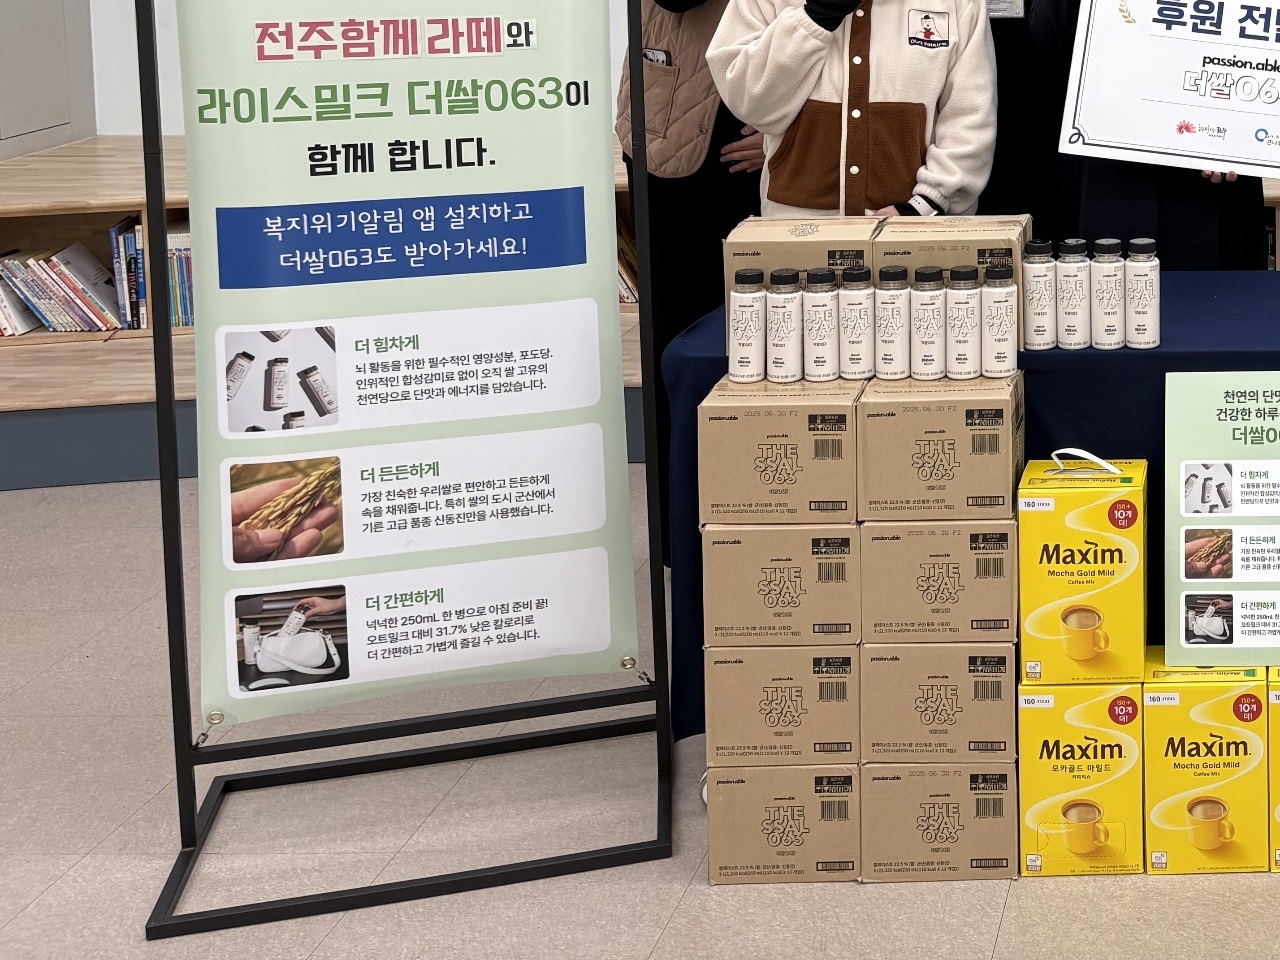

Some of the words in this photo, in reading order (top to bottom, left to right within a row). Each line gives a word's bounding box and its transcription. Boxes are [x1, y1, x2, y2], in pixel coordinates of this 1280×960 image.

[255, 17, 420, 61] 전주함께
[197, 83, 393, 124] 라이스밀크
[408, 77, 589, 115] 더쌀063이
[308, 143, 374, 176] 함께
[388, 138, 495, 172] 합니다.
[263, 208, 402, 241] 복지위기알림
[413, 206, 434, 231] 앱
[445, 202, 533, 229] 설치하고
[280, 247, 396, 273] 더쌀063도
[404, 237, 526, 267] 받아가세요!
[355, 338, 369, 354] 더
[373, 334, 419, 353] 힘차게
[356, 363, 366, 374] 뇌
[369, 360, 401, 373] 활동을
[404, 358, 425, 370] 위한
[428, 354, 470, 368] 필수적인
[473, 352, 516, 364] 영양성분,
[520, 348, 552, 360] 포도당.
[356, 376, 399, 390] 인위적인
[402, 372, 455, 386] 합성감미료
[458, 369, 478, 381] 없이
[481, 367, 501, 378] 오직
[504, 366, 514, 377] 쌀
[517, 363, 547, 375] 고유의
[357, 391, 411, 405] 천연당으로
[414, 387, 445, 400] 단맛과
[448, 384, 490, 397] 에너지를
[492, 379, 546, 394] 담았습니다.
[1224, 390, 1258, 403] 천연의
[1216, 408, 1252, 421] 건강한
[757, 443, 798, 458] THE
[361, 468, 375, 483] 더
[379, 461, 439, 482] 든든하게
[753, 457, 803, 471] SSAL
[362, 491, 382, 503] 가장
[386, 488, 418, 501] 친숙한
[420, 484, 462, 497] 우리쌀로
[465, 479, 506, 492] 편안하고
[509, 474, 549, 488] 든든하게
[760, 470, 797, 485] 063
[362, 506, 383, 518] 속을
[386, 500, 442, 515] 채워줍니다.
[445, 497, 465, 509] 특히
[468, 495, 488, 507] 쌀의
[492, 492, 512, 504] 도시
[515, 488, 555, 502] 군산에서
[1114, 509, 1133, 519] 10개
[363, 522, 384, 533] 기른
[386, 519, 408, 530] 고급
[410, 516, 432, 528] 품종
[434, 510, 487, 526] 신동진만을
[489, 503, 553, 519] 사용했습니다.
[1047, 569, 1075, 577] Mocha
[1076, 569, 1096, 577] Gold
[1097, 569, 1115, 577] Mild
[366, 596, 380, 611] 더
[384, 588, 444, 609] 간편하게
[1241, 602, 1247, 610] 더
[1250, 602, 1276, 610] 간편하게
[366, 617, 398, 630] 넉넉한
[401, 613, 440, 626] 250mL
[442, 610, 452, 621] 한
[455, 606, 486, 619] 병으로
[489, 603, 509, 615] 아침
[512, 600, 532, 612] 준비
[535, 599, 548, 609] 끝!
[367, 632, 410, 645] 오트밀크
[412, 628, 432, 639] 대비
[436, 624, 467, 636] 31.7%
[470, 621, 491, 633] 낮은
[494, 615, 536, 631] 칼로리로
[368, 650, 378, 660] 더
[381, 645, 423, 659] 간편하고
[426, 640, 457, 652] 가볍게
[460, 636, 480, 649] 즐길
[483, 636, 494, 645] 수
[496, 630, 540, 644] 있습니다.
[1149, 695, 1161, 703] 160
[1239, 704, 1257, 713] 10개
[1114, 706, 1133, 715] 10개
[1051, 763, 1084, 773] 모카골드
[1087, 763, 1112, 773] 마일드
[1173, 762, 1200, 770] Mocha
[1202, 761, 1221, 770] Gold
[1222, 761, 1240, 769] Mild
